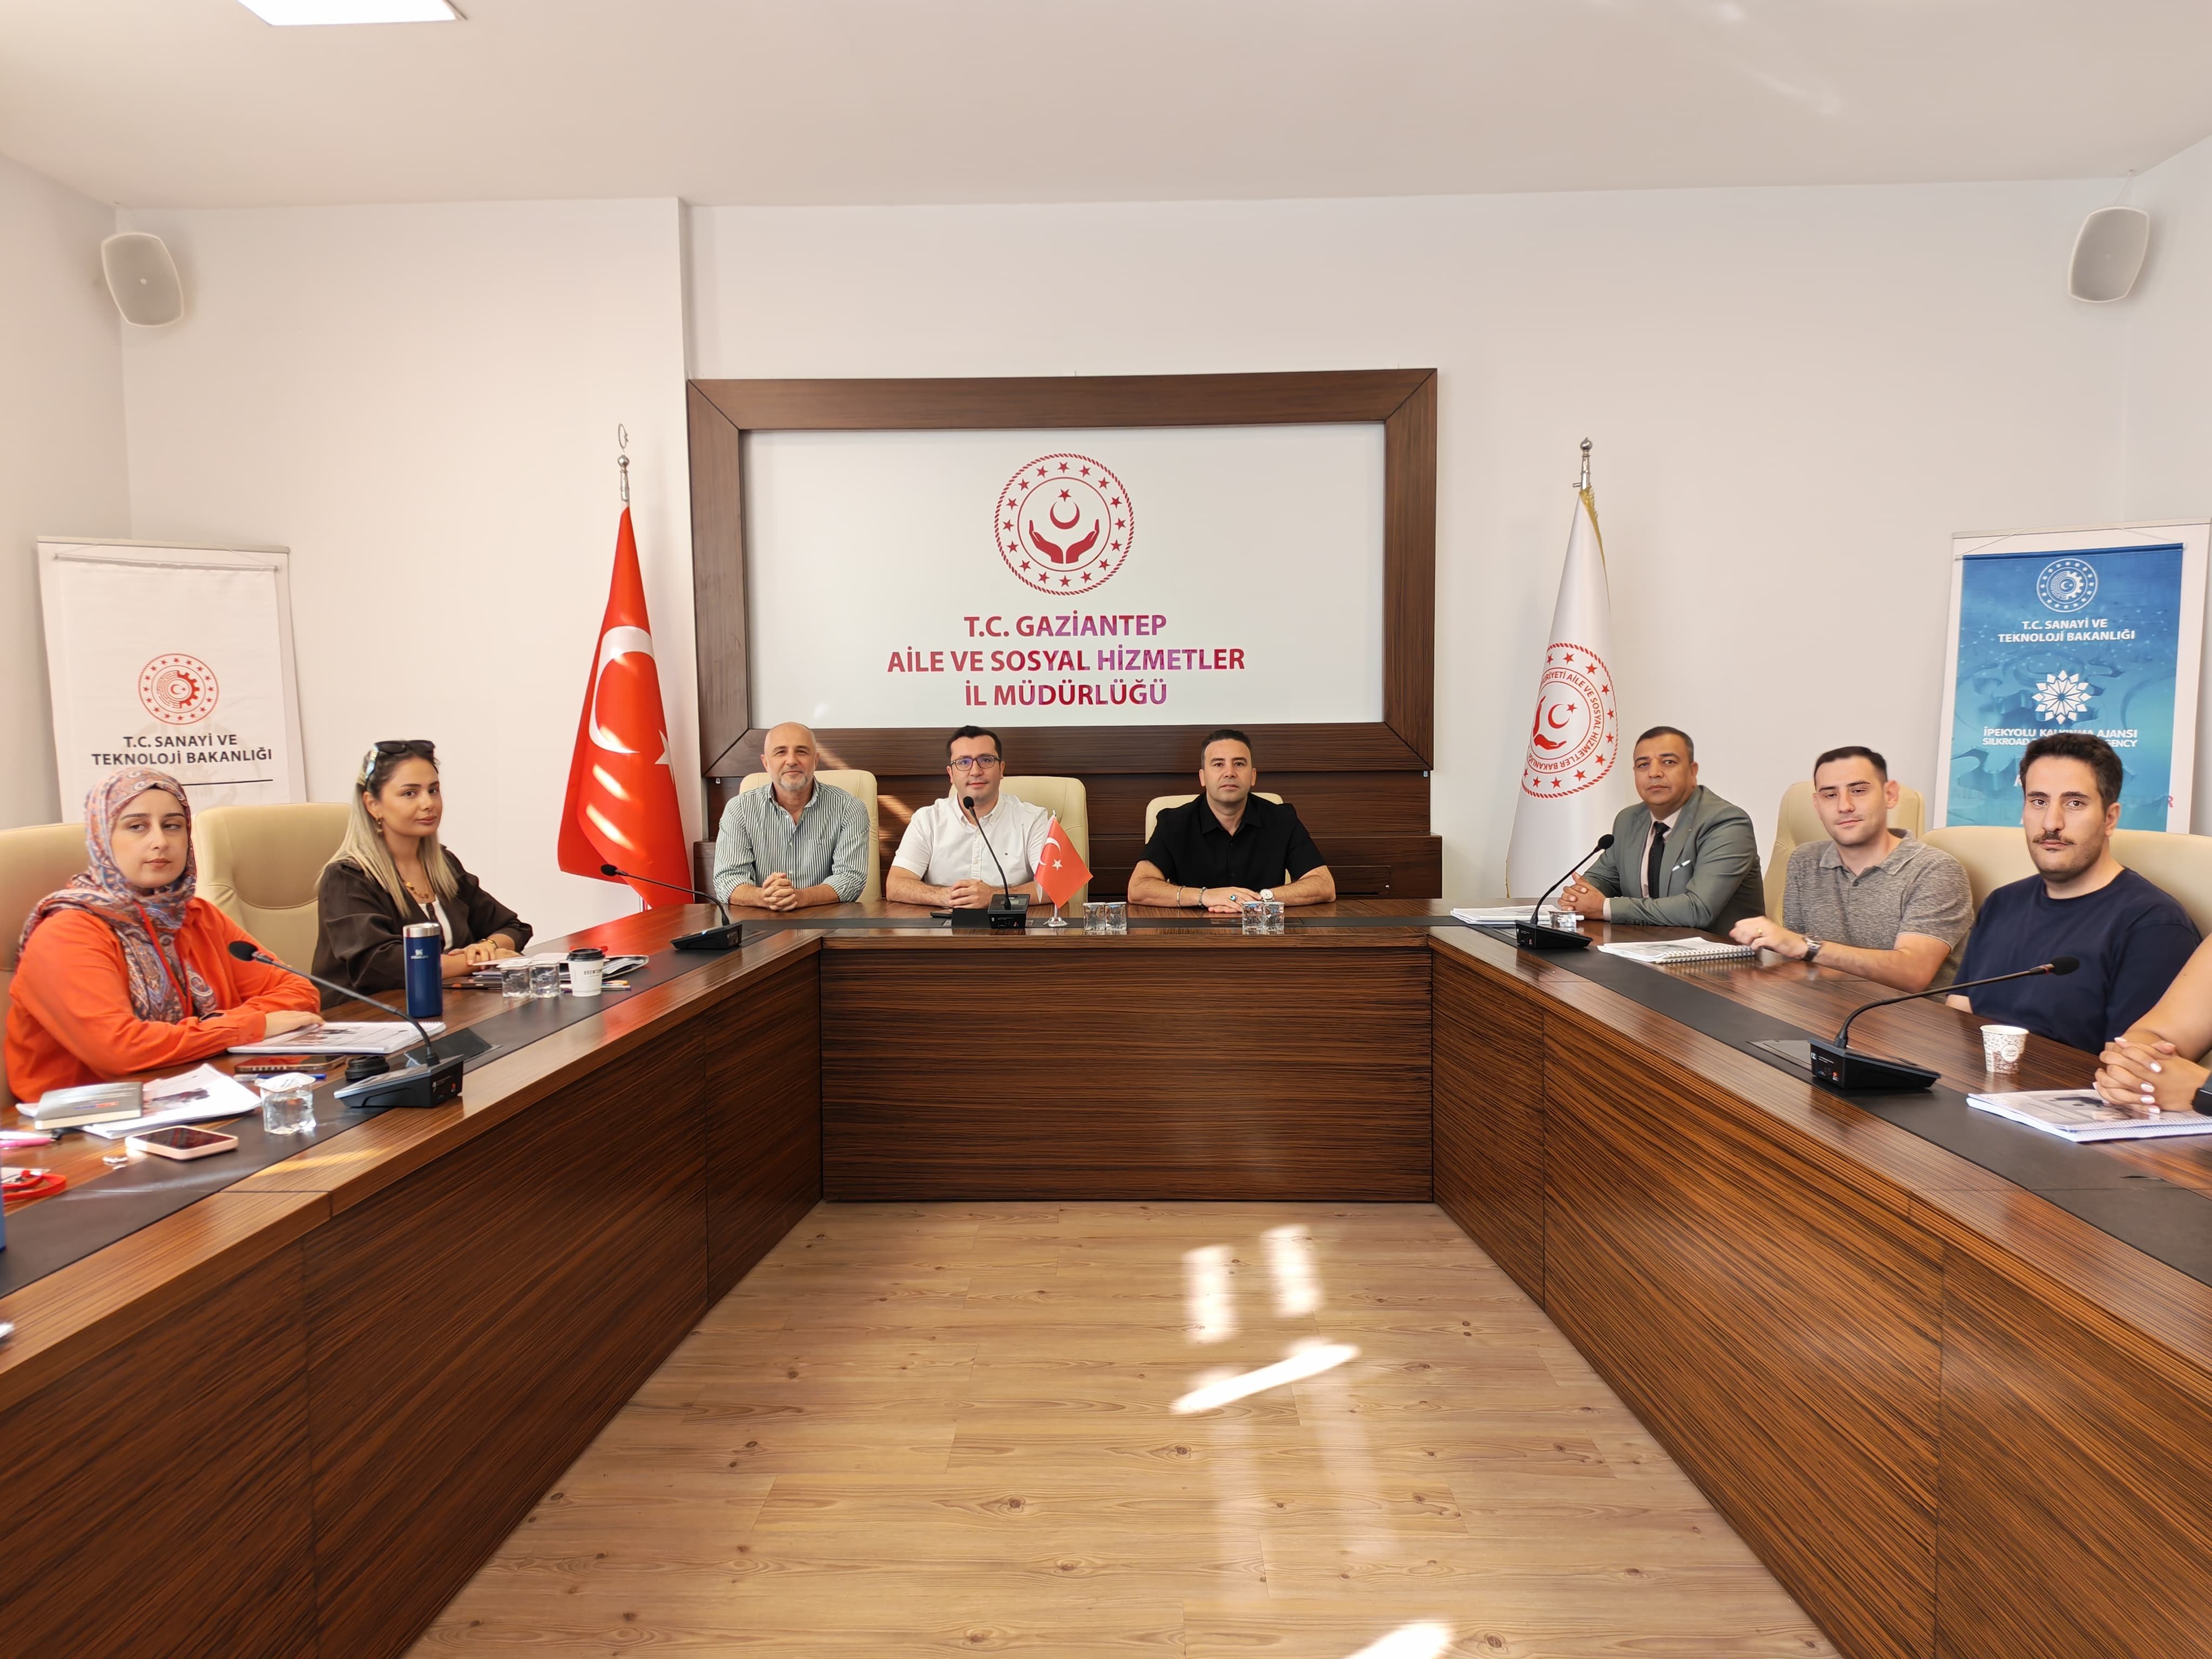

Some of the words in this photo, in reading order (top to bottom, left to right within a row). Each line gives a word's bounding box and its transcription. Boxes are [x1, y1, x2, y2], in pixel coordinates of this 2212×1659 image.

[964, 616, 1009, 637] T.C.
[1016, 610, 1166, 637] GAZİANTEP
[2021, 621, 2043, 630] T.C.
[2045, 618, 2089, 630] SANAYİ
[2091, 618, 2108, 628] VE
[1997, 631, 2065, 643] TEKNOLOJİ
[2066, 629, 2135, 642] BAKANLIĞI
[887, 646, 944, 672] AİLE
[950, 651, 983, 672] VE
[991, 650, 1090, 672] SOSYAL
[1098, 644, 1245, 671] HİZMETLER
[1567, 673, 1586, 688] AİLE
[966, 680, 987, 706] İL
[994, 678, 1167, 706] MÜDÜRLÜĞÜ
[1583, 685, 1594, 698] VE
[1590, 697, 1601, 730] SOSYAL
[1983, 726, 2036, 737] İPEKYOLU
[2096, 729, 2138, 738] AJANSI
[123, 736, 151, 748] T.C.
[154, 733, 213, 747] SANAYİ
[217, 734, 238, 746] VE
[2105, 739, 2138, 747] GENCY
[91, 751, 181, 765] TEKNOLOJİ
[186, 747, 272, 764] BAKANLIĞI
[1560, 732, 1599, 768] HİZMETLER
